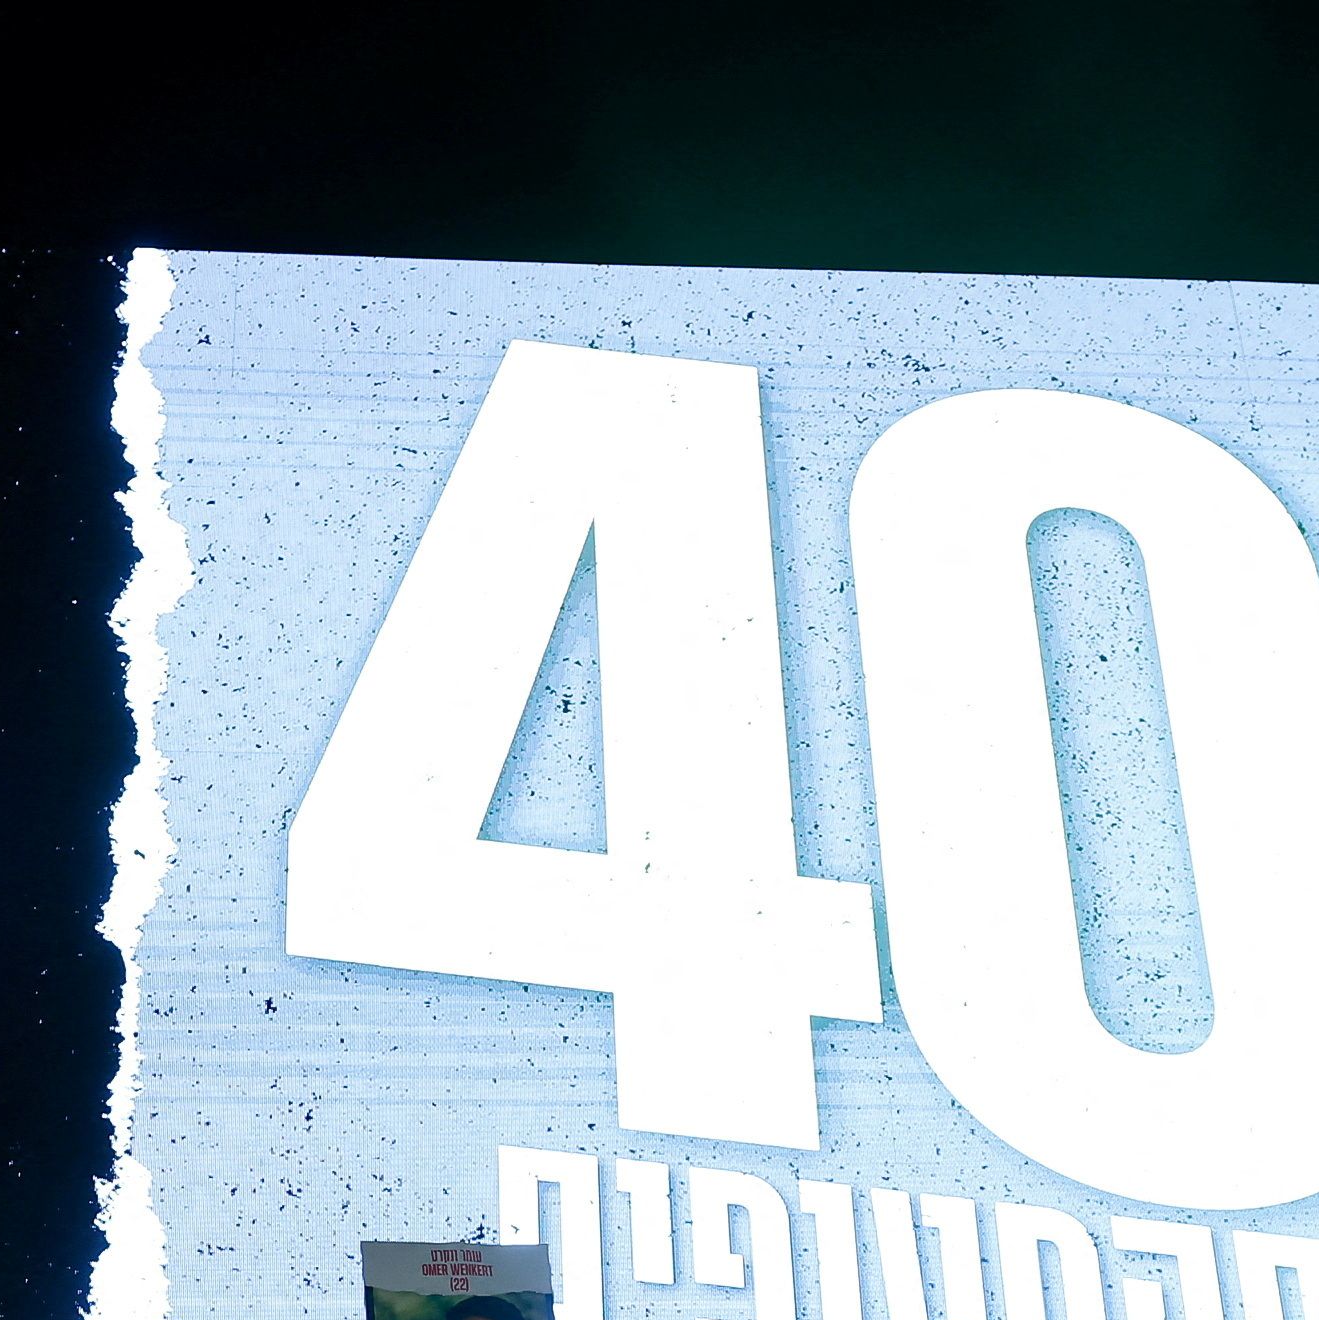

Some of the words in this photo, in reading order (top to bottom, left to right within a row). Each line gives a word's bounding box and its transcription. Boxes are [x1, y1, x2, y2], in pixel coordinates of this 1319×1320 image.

[422, 1264, 448, 1276] OMER
[451, 1264, 494, 1277] WENKERT
[450, 1277, 469, 1292] (22)
